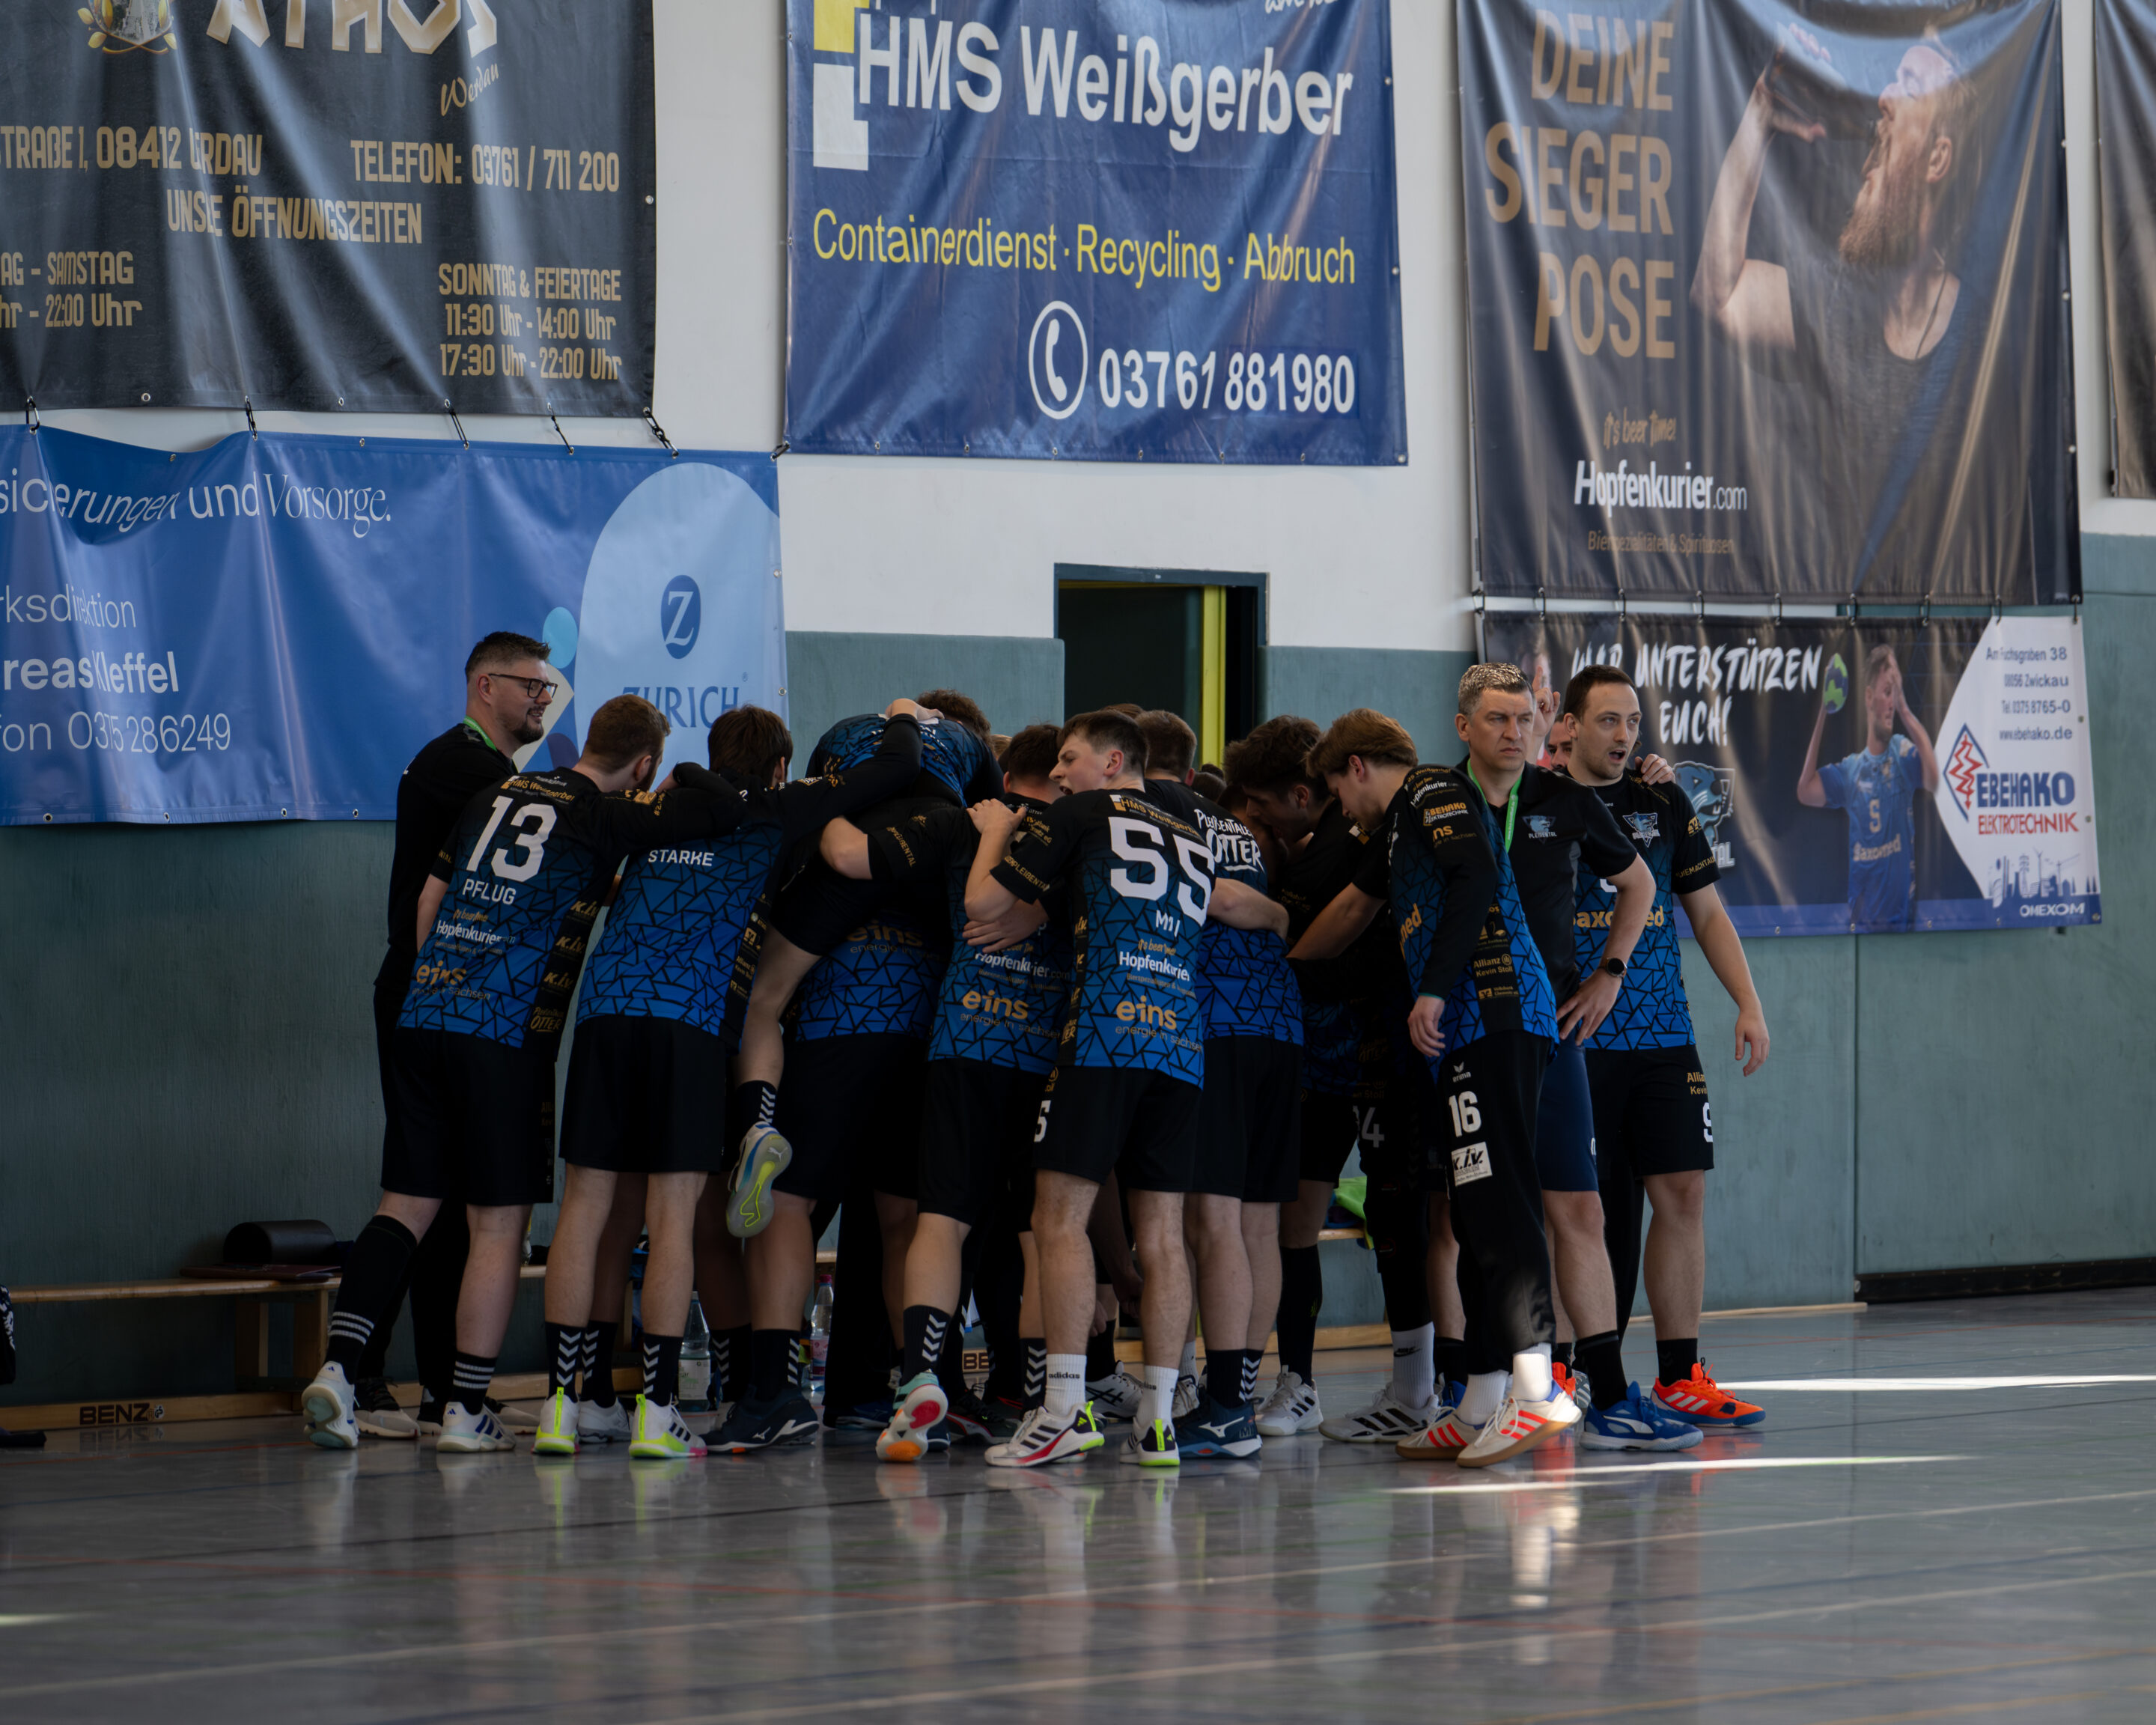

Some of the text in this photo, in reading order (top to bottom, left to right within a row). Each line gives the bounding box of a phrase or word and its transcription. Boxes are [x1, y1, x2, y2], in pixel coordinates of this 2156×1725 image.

[1532, 8, 1674, 112] DEINE
[440, 63, 500, 117] Werdau
[859, 13, 1353, 152] HMS Weißgerber
[97, 126, 183, 169] 08412
[350, 140, 463, 185] TELEFON:
[472, 144, 520, 188] 03761
[543, 149, 571, 191] 711
[579, 151, 620, 192] 200
[1484, 122, 1674, 237] SIEGER
[231, 184, 422, 244] ÖFFNUNGSZEITEN
[813, 207, 1356, 292] Containerdienst Recycling Abbruch
[47, 252, 134, 286] SAMSTAG
[439, 263, 622, 301] SONNTAG & FEIERTAGE
[45, 293, 84, 327] 22:00
[91, 293, 142, 327] Uhr
[445, 303, 495, 335] 11:30
[499, 304, 523, 337] Uhr
[536, 307, 579, 339] 14:00
[585, 308, 616, 340] Uhr
[1533, 252, 1675, 359] POSE
[440, 344, 496, 376] 17:30
[502, 344, 526, 377] Uhr
[539, 347, 585, 380] 22:00
[590, 348, 622, 380] Uhr
[1099, 348, 1356, 414] 03761 881980
[189, 471, 260, 519] und
[264, 473, 392, 538] Vorsorge.
[1574, 459, 1747, 518] Hopfenkurier.com
[0, 583, 137, 629] ksdirektion
[91, 650, 179, 693] Kleffel
[1635, 638, 1824, 693] UNTERSTÜTZEN
[2050, 646, 2068, 660] 38
[2024, 673, 2069, 687] Zwickau
[622, 685, 739, 728] URICH
[1659, 694, 1733, 746] EUCH!
[0, 714, 52, 752] on
[127, 713, 231, 754] 286249
[1121, 797, 1147, 813] HMS
[1977, 771, 2075, 808] EBEHAKO
[1430, 803, 1467, 816] BEHAKO
[1978, 812, 2080, 836] ELEKTROTECHNIK
[466, 795, 557, 882] 13
[1206, 828, 1265, 874] OTTER
[648, 849, 715, 867] STARKE
[1108, 816, 1216, 928] 55
[462, 878, 517, 906] PFLUG
[2019, 902, 2086, 918] OMEXOM
[844, 918, 923, 947] eins
[1473, 958, 1500, 969] Allianz
[1475, 965, 1514, 977] Kevin Stoll
[960, 1012, 1001, 1026] energie
[1004, 1019, 1014, 1029] in
[962, 989, 1029, 1020] eins
[1115, 995, 1178, 1030] eins
[1115, 1025, 1157, 1038] energie
[1452, 1071, 1472, 1083] erima
[1448, 1090, 1482, 1138] 16
[1048, 1371, 1080, 1379] adidas
[79, 1403, 150, 1425] BENZ
